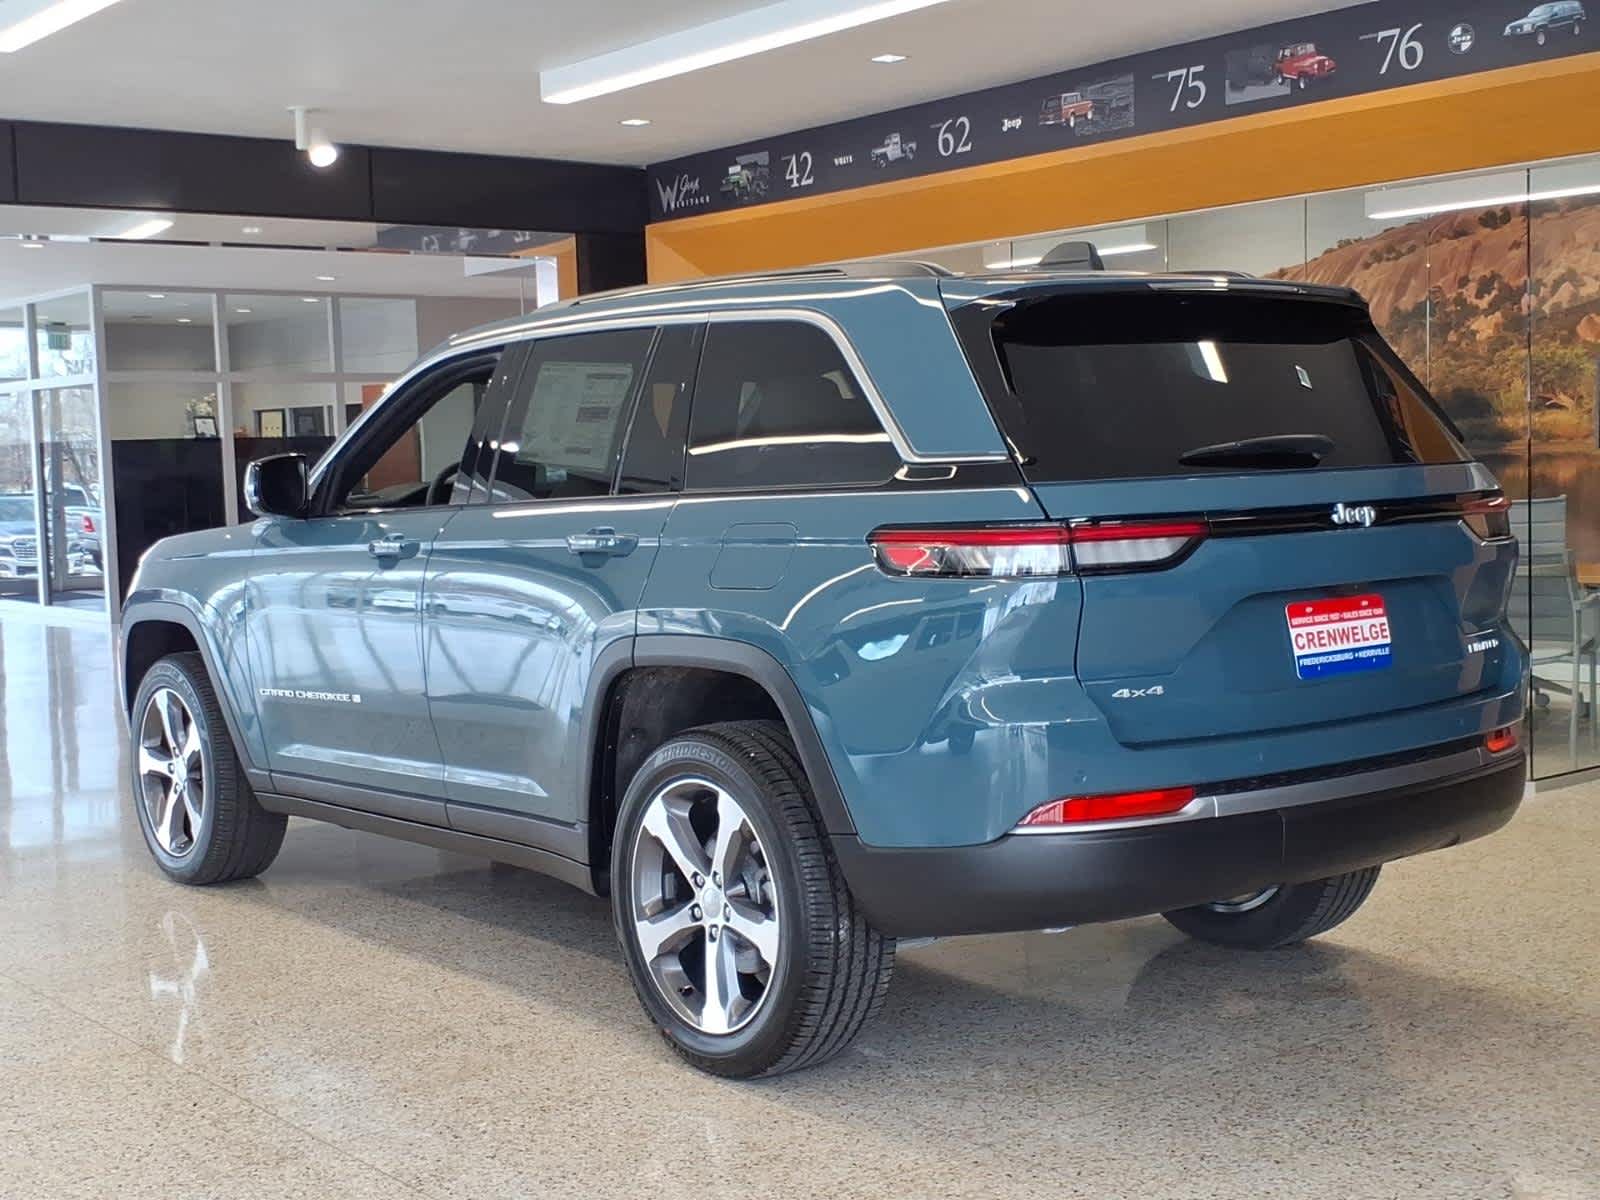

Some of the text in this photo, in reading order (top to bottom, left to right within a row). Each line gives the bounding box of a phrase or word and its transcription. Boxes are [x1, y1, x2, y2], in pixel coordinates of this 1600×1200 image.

[1377, 23, 1424, 74] 76
[1168, 65, 1206, 112] 75
[938, 116, 972, 157] 62
[1002, 116, 1022, 132] Jeep
[785, 152, 814, 188] 42
[1331, 503, 1376, 527] Jeep
[1294, 622, 1389, 650] CRENWELGE
[1299, 647, 1390, 667] FREDERICKSBURG KERRVILLE
[259, 688, 351, 702] GRAND CHEROKEE
